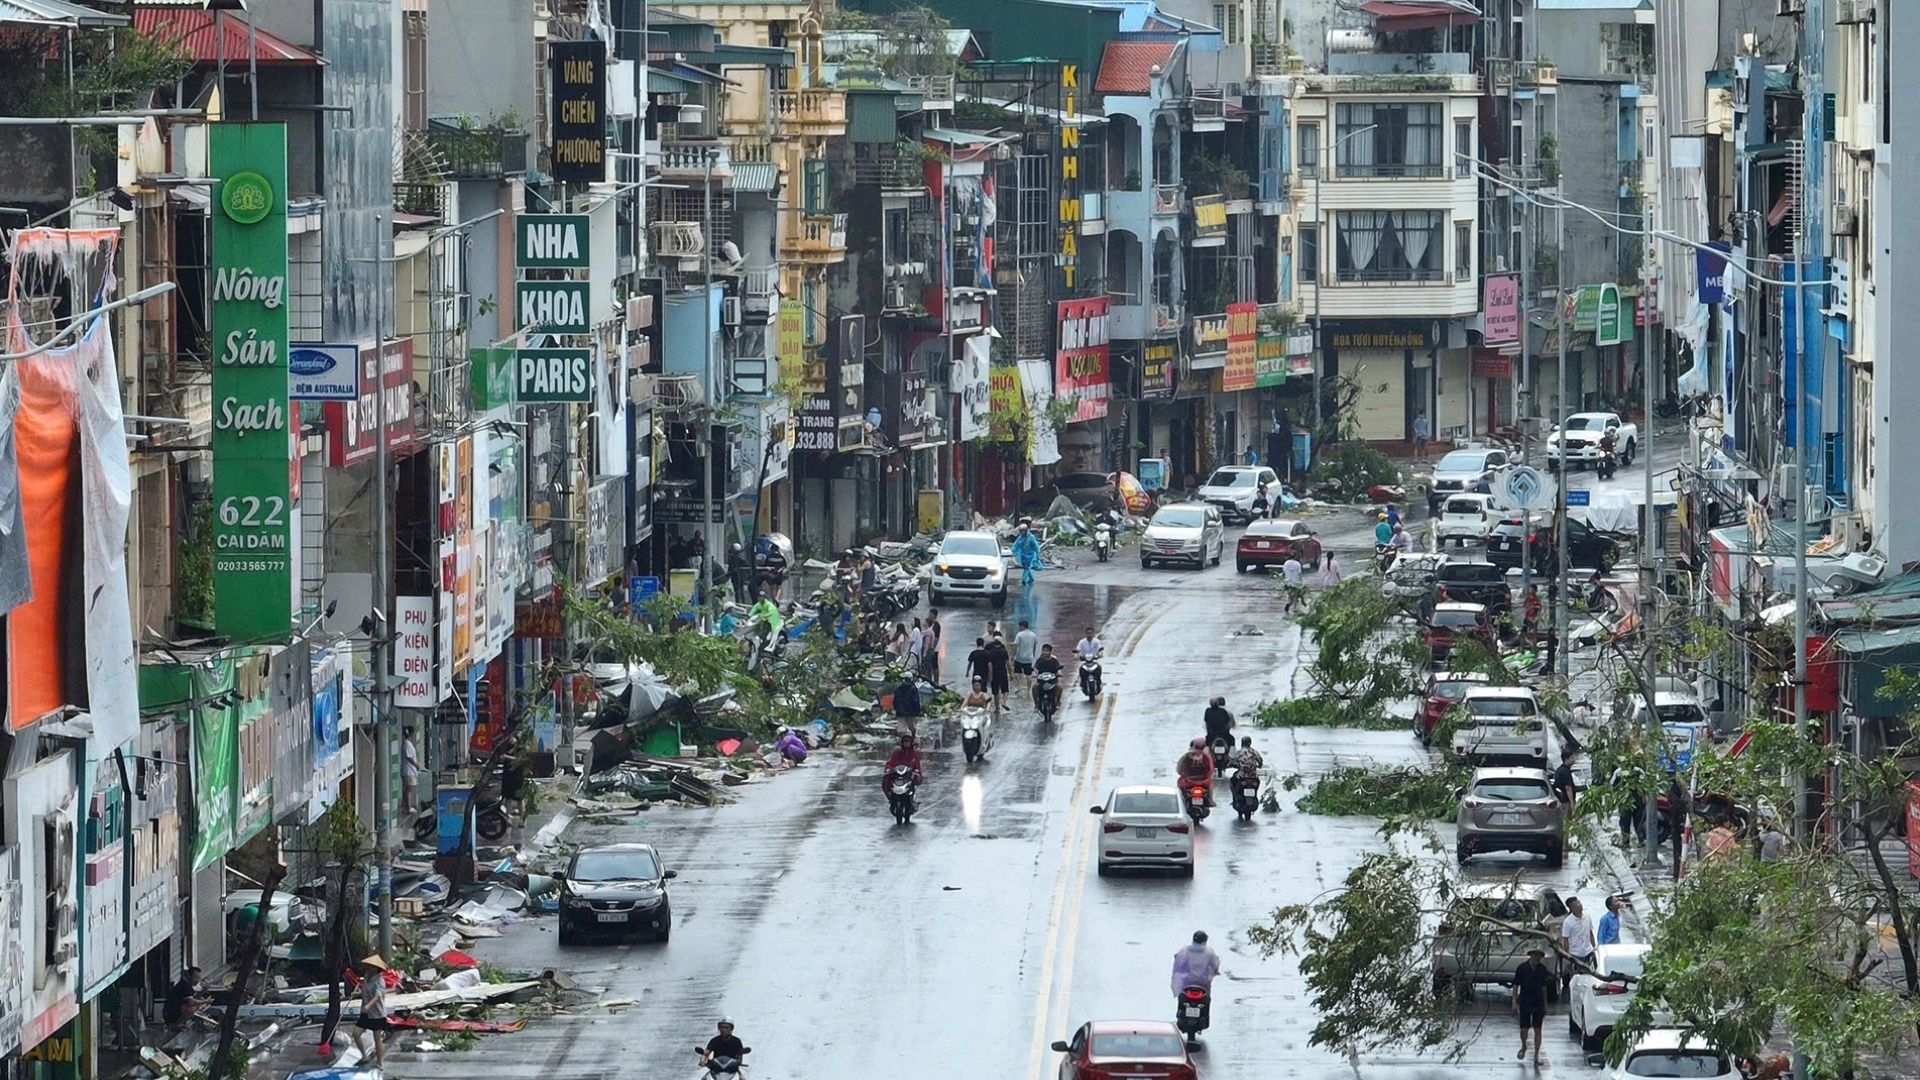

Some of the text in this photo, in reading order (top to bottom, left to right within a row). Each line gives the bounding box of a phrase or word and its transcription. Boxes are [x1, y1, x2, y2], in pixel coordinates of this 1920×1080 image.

[563, 56, 594, 84] VÀNG
[561, 93, 596, 125] CHIẾN
[1061, 65, 1078, 180] KÍNH
[556, 139, 601, 168] PHƯỢNG
[526, 223, 580, 260] NHA
[213, 267, 284, 308] Nông
[521, 290, 585, 327] KHOA
[221, 328, 278, 366] Sản
[314, 384, 354, 394] AUSTRALIA
[520, 358, 586, 394] PARIS
[216, 397, 283, 437] Sạch
[802, 416, 834, 428] TRANG
[219, 496, 284, 526] 622
[217, 530, 285, 549] CAI DĂM
[404, 610, 427, 627] PHỤ
[404, 632, 429, 651] KIỆN
[404, 656, 428, 674] ĐIỆN
